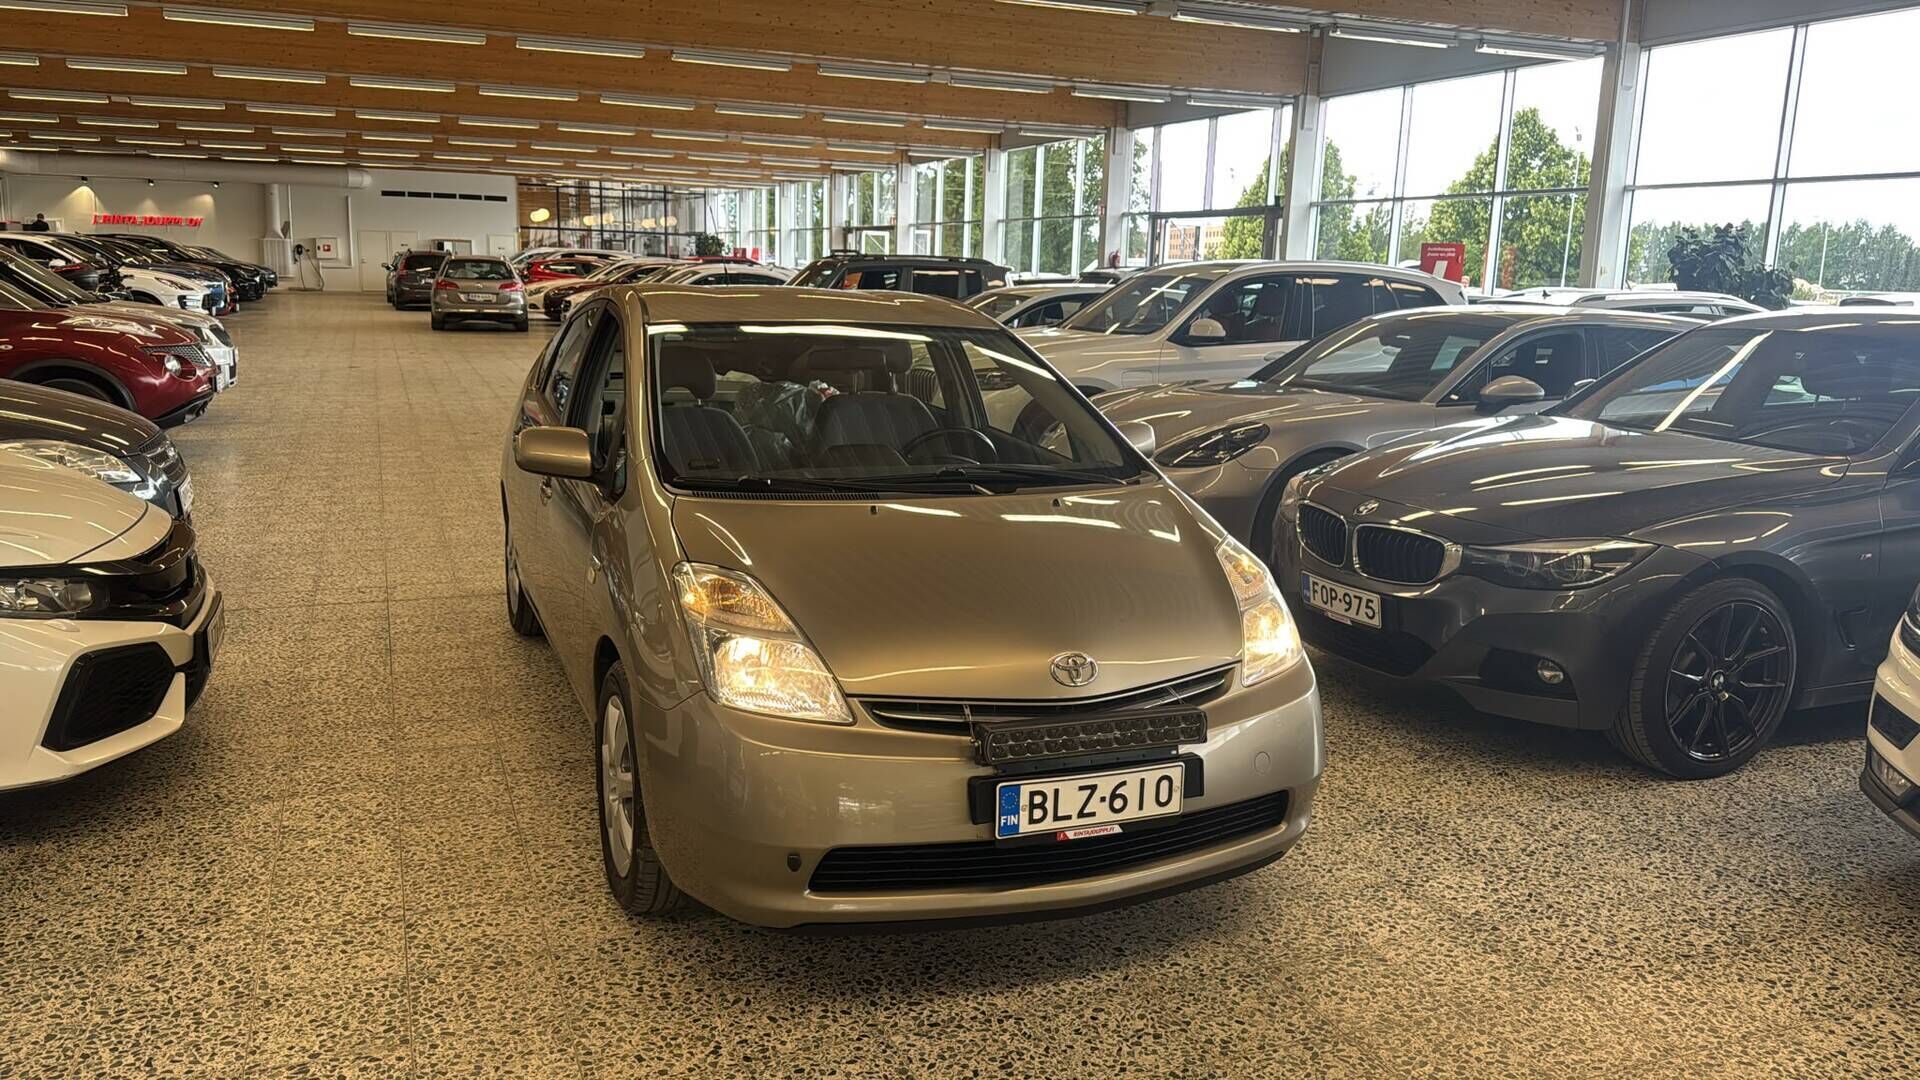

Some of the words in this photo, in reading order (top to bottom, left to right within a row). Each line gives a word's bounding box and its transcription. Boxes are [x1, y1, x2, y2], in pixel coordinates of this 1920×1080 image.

[1312, 580, 1376, 620] FOP-975
[1028, 774, 1174, 825] BLZ-610
[1000, 814, 1019, 827] FIN
